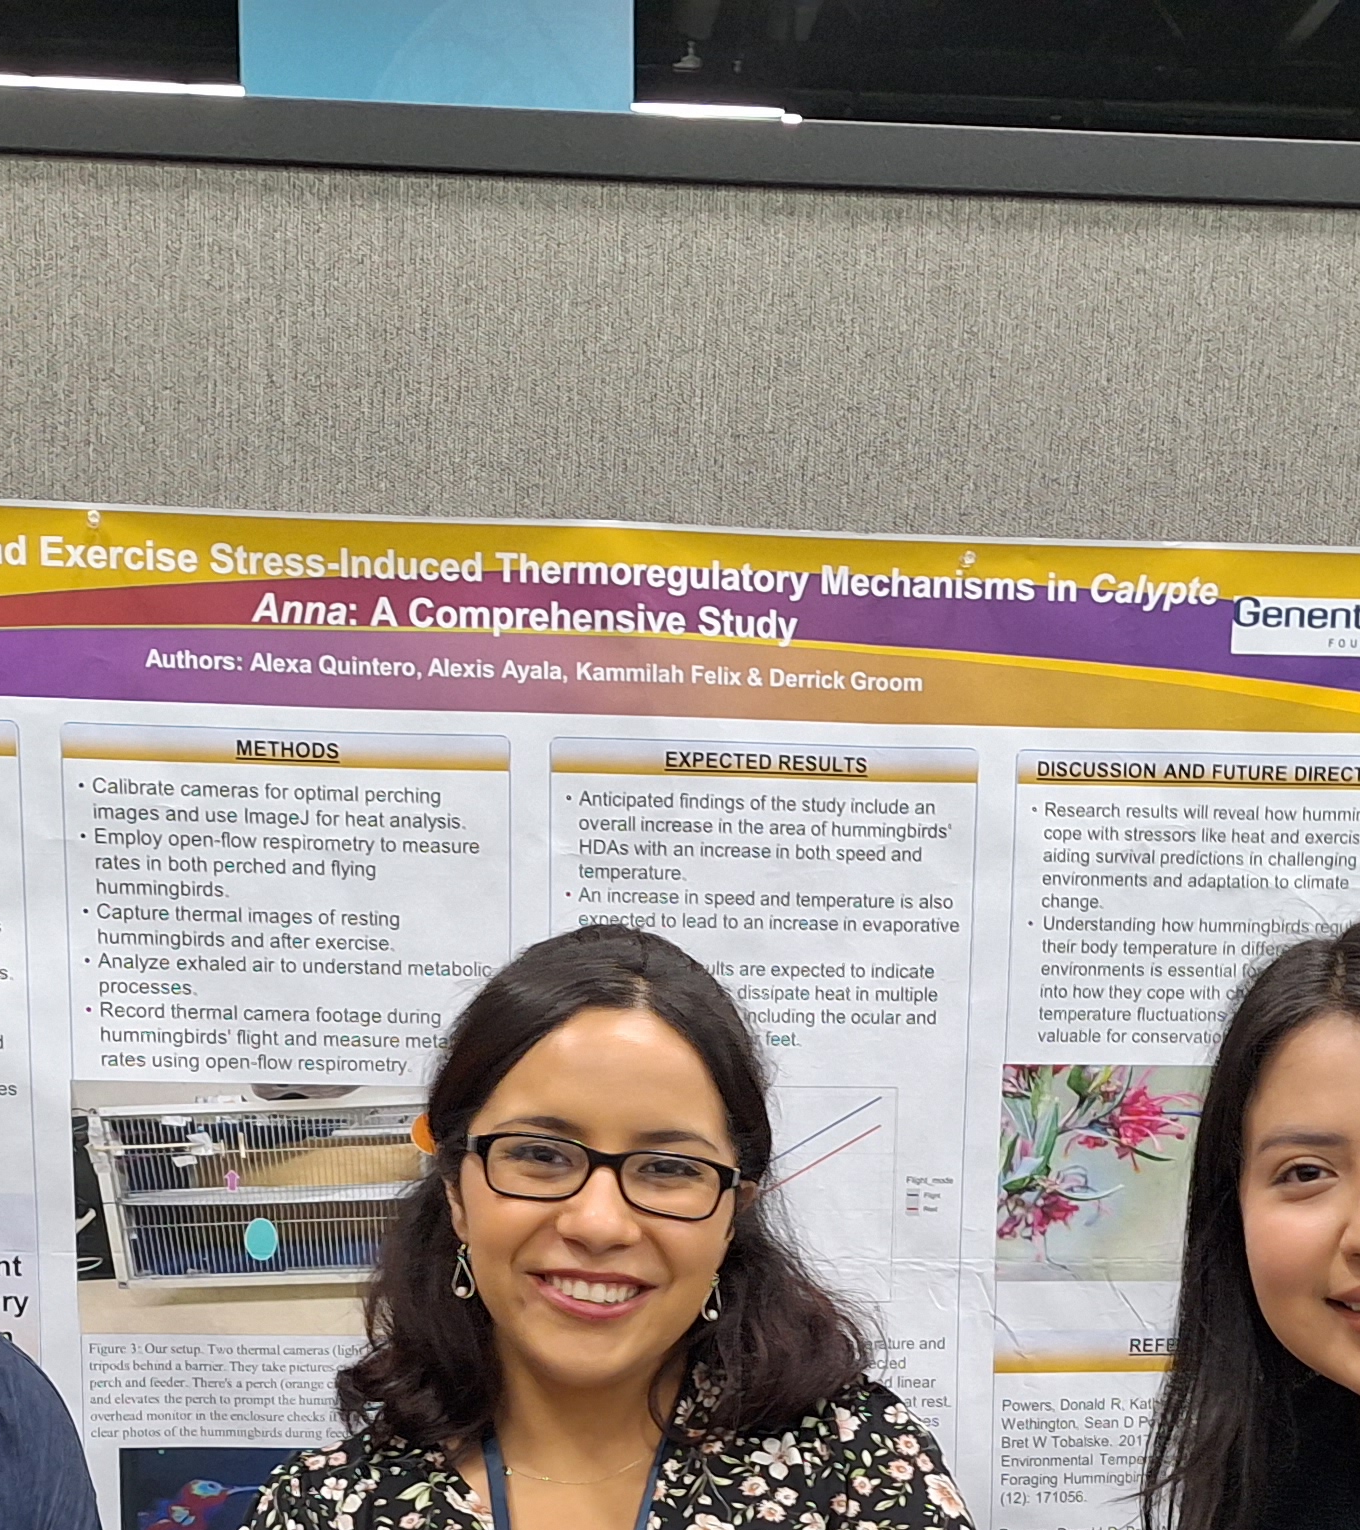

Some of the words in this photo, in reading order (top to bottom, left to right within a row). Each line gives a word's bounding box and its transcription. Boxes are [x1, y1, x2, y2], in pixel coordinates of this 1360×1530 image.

[40, 535, 199, 573] Exercise
[209, 541, 483, 583] Stress-Induced
[495, 551, 810, 602] Thermoregulatory
[821, 562, 1036, 602] Mechanisms
[1048, 572, 1078, 604] in
[1090, 573, 1219, 612] Calypte
[251, 592, 358, 627] Anna:
[369, 596, 399, 628] A
[408, 596, 687, 637] Comprehensive
[697, 605, 799, 648] Study
[144, 648, 244, 671] Authors:
[249, 652, 313, 674] Alexa
[318, 655, 423, 681] Quintero,
[427, 657, 495, 679] Alexis
[501, 659, 569, 684] Ayala,
[576, 661, 685, 684] Kammilah
[691, 664, 742, 687] Felix
[747, 667, 764, 688] &
[769, 669, 846, 691] Derrick
[850, 671, 924, 692] Groom
[235, 739, 340, 760] METHODS
[664, 750, 772, 771] EXPECTED
[778, 753, 868, 774] RESULTS
[1037, 760, 1156, 779] DISCUSSION
[1163, 762, 1206, 780] AND
[1212, 764, 1288, 782] FUTURE
[91, 776, 176, 798] Calibrate
[179, 782, 260, 800] cameras
[263, 781, 290, 801] for
[292, 783, 360, 806] optimal
[364, 785, 442, 810] perching
[577, 789, 675, 813] Anticipated
[678, 791, 746, 815] findings
[749, 793, 769, 812] of
[769, 794, 798, 813] the
[800, 795, 847, 819] study
[849, 796, 911, 816] include
[913, 801, 937, 816] an
[92, 801, 161, 826] images
[164, 804, 200, 824] and
[204, 809, 239, 825] use
[243, 806, 310, 830] ImageJ
[314, 808, 341, 828] for
[344, 809, 386, 830] heat
[388, 811, 467, 834] analysis.
[1044, 800, 1122, 819] Research
[1125, 802, 1179, 820] results
[1182, 802, 1210, 821] will
[1212, 804, 1261, 822] reveal
[1263, 804, 1298, 823] how
[88, 1342, 127, 1357] Figure
[144, 1343, 168, 1355] Our
[207, 1344, 234, 1356] Two
[236, 1344, 281, 1357] thermal
[283, 1346, 330, 1357] cameras
[1001, 1399, 1056, 1413] Powers,
[1060, 1398, 1106, 1412] Donald
[1084, 1416, 1119, 1429] Sean
[1123, 1416, 1135, 1428] D
[1001, 1436, 1030, 1449] Bret
[1032, 1436, 1048, 1448] W
[1001, 1454, 1094, 1468] Environmental
[1000, 1473, 1058, 1488] Foraging
